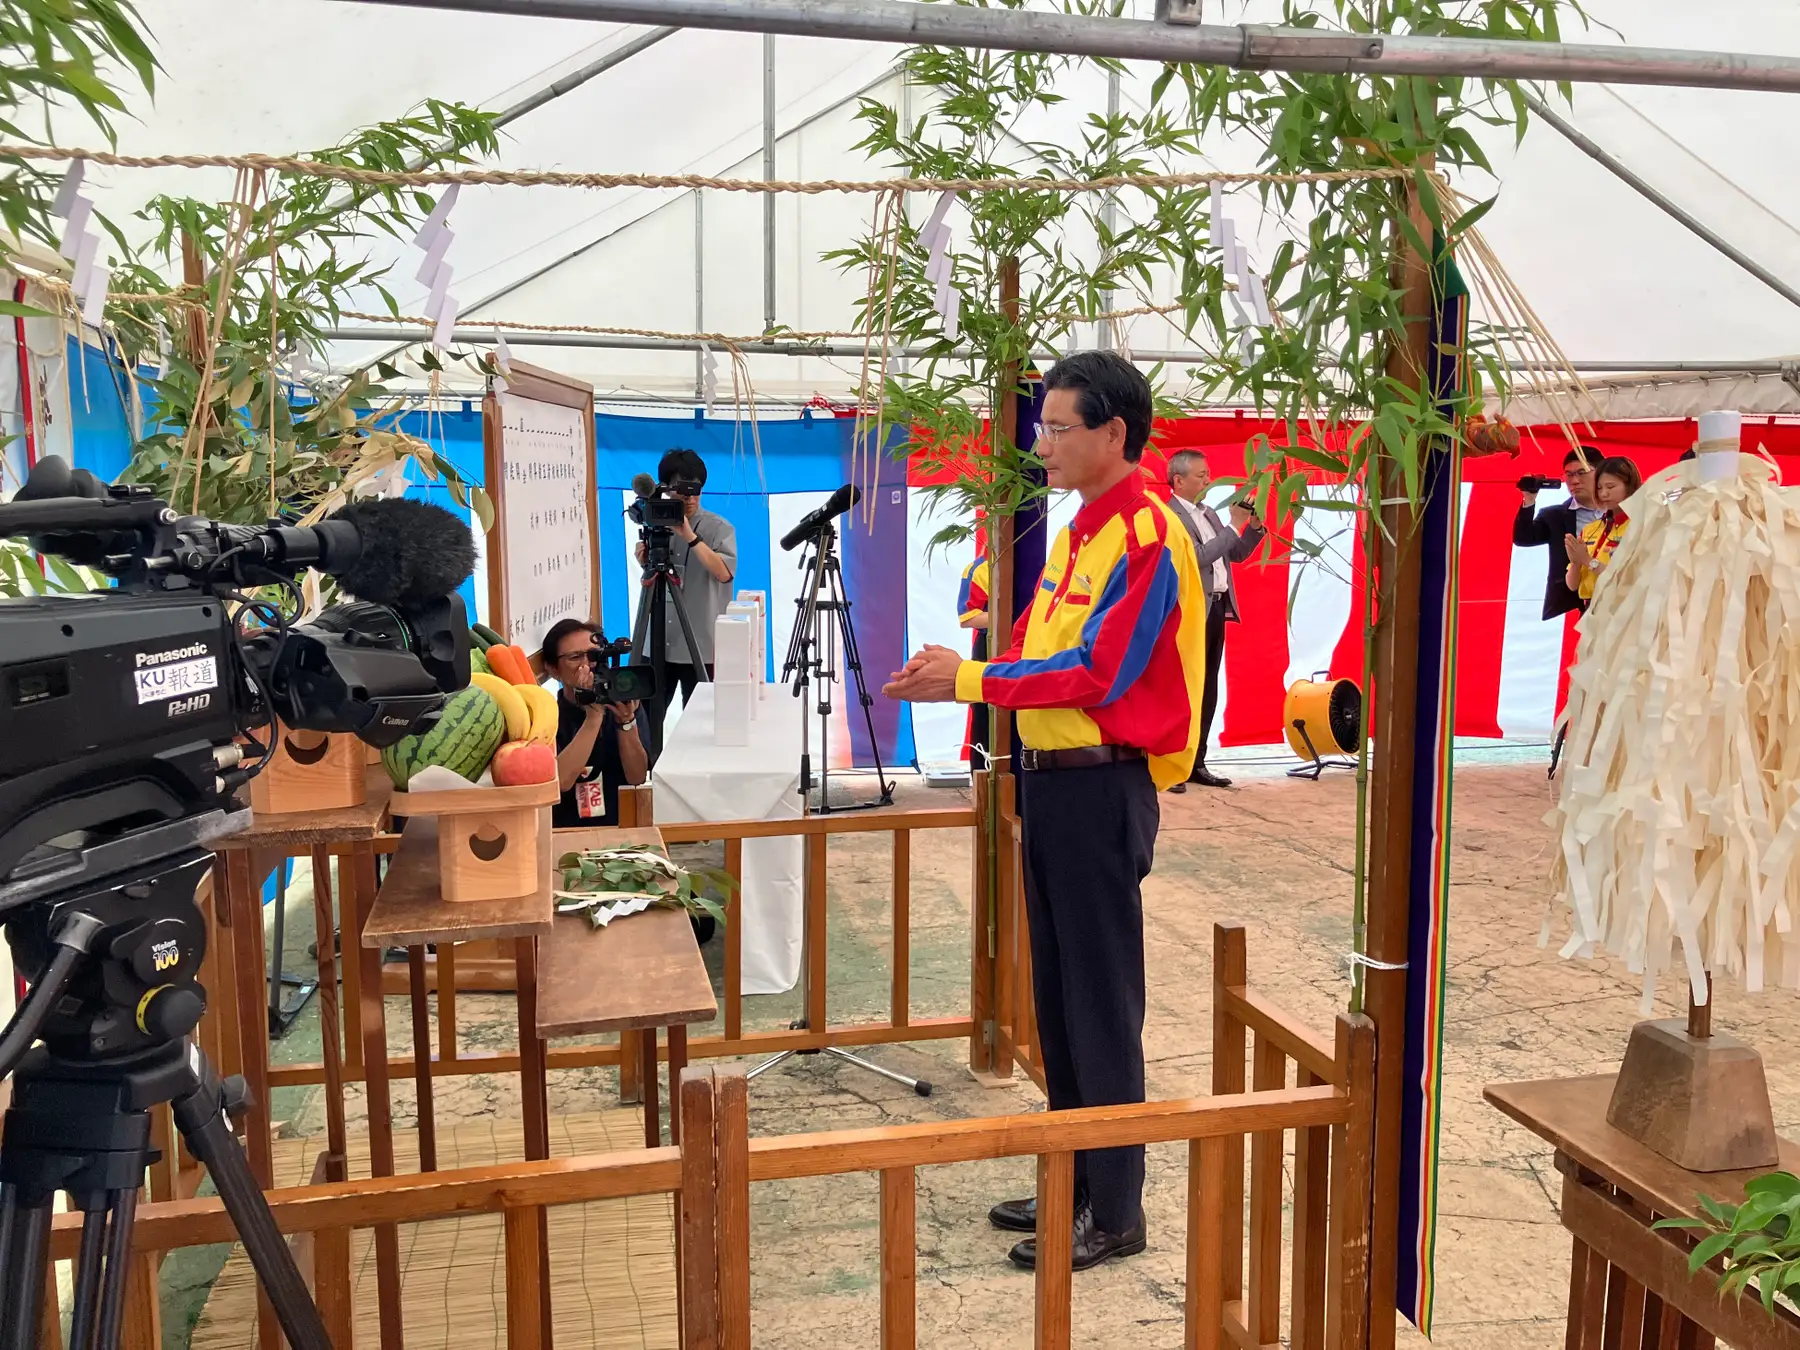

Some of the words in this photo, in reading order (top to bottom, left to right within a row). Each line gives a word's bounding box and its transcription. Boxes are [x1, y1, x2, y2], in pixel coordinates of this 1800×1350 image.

[135, 642, 208, 667] Panasonic
[167, 693, 211, 717] P2HD
[381, 715, 410, 726] Canon
[589, 783, 602, 807] KAB
[152, 939, 177, 953] Vision
[152, 946, 179, 972] 100
